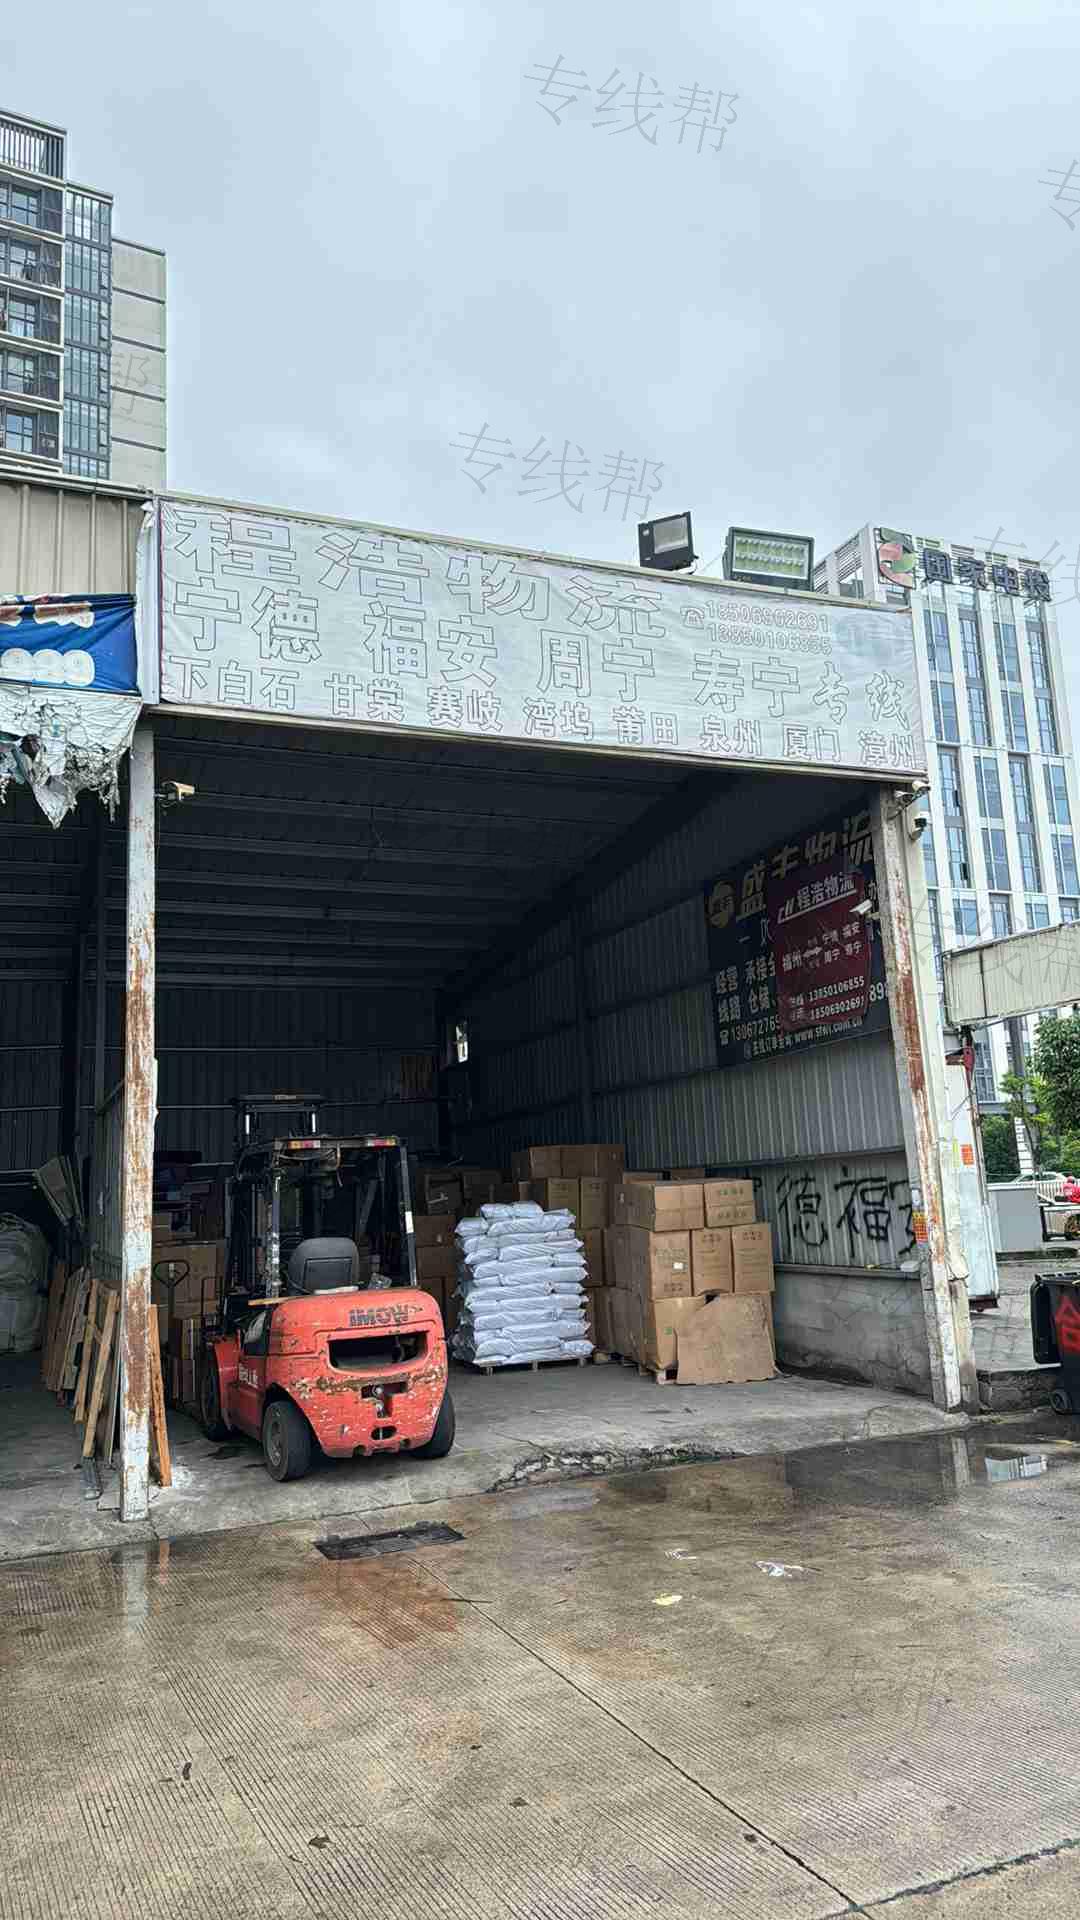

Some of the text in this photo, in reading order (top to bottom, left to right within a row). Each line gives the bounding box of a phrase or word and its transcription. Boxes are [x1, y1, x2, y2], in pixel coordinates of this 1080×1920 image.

[174, 508, 666, 638] 程浩物流
[168, 655, 917, 770] 下白石 甘棠 赛岐 湾坞 莆田 泉州 厦门 漳州
[173, 576, 911, 731] 宁德 福安 周宁 寿宁 专线
